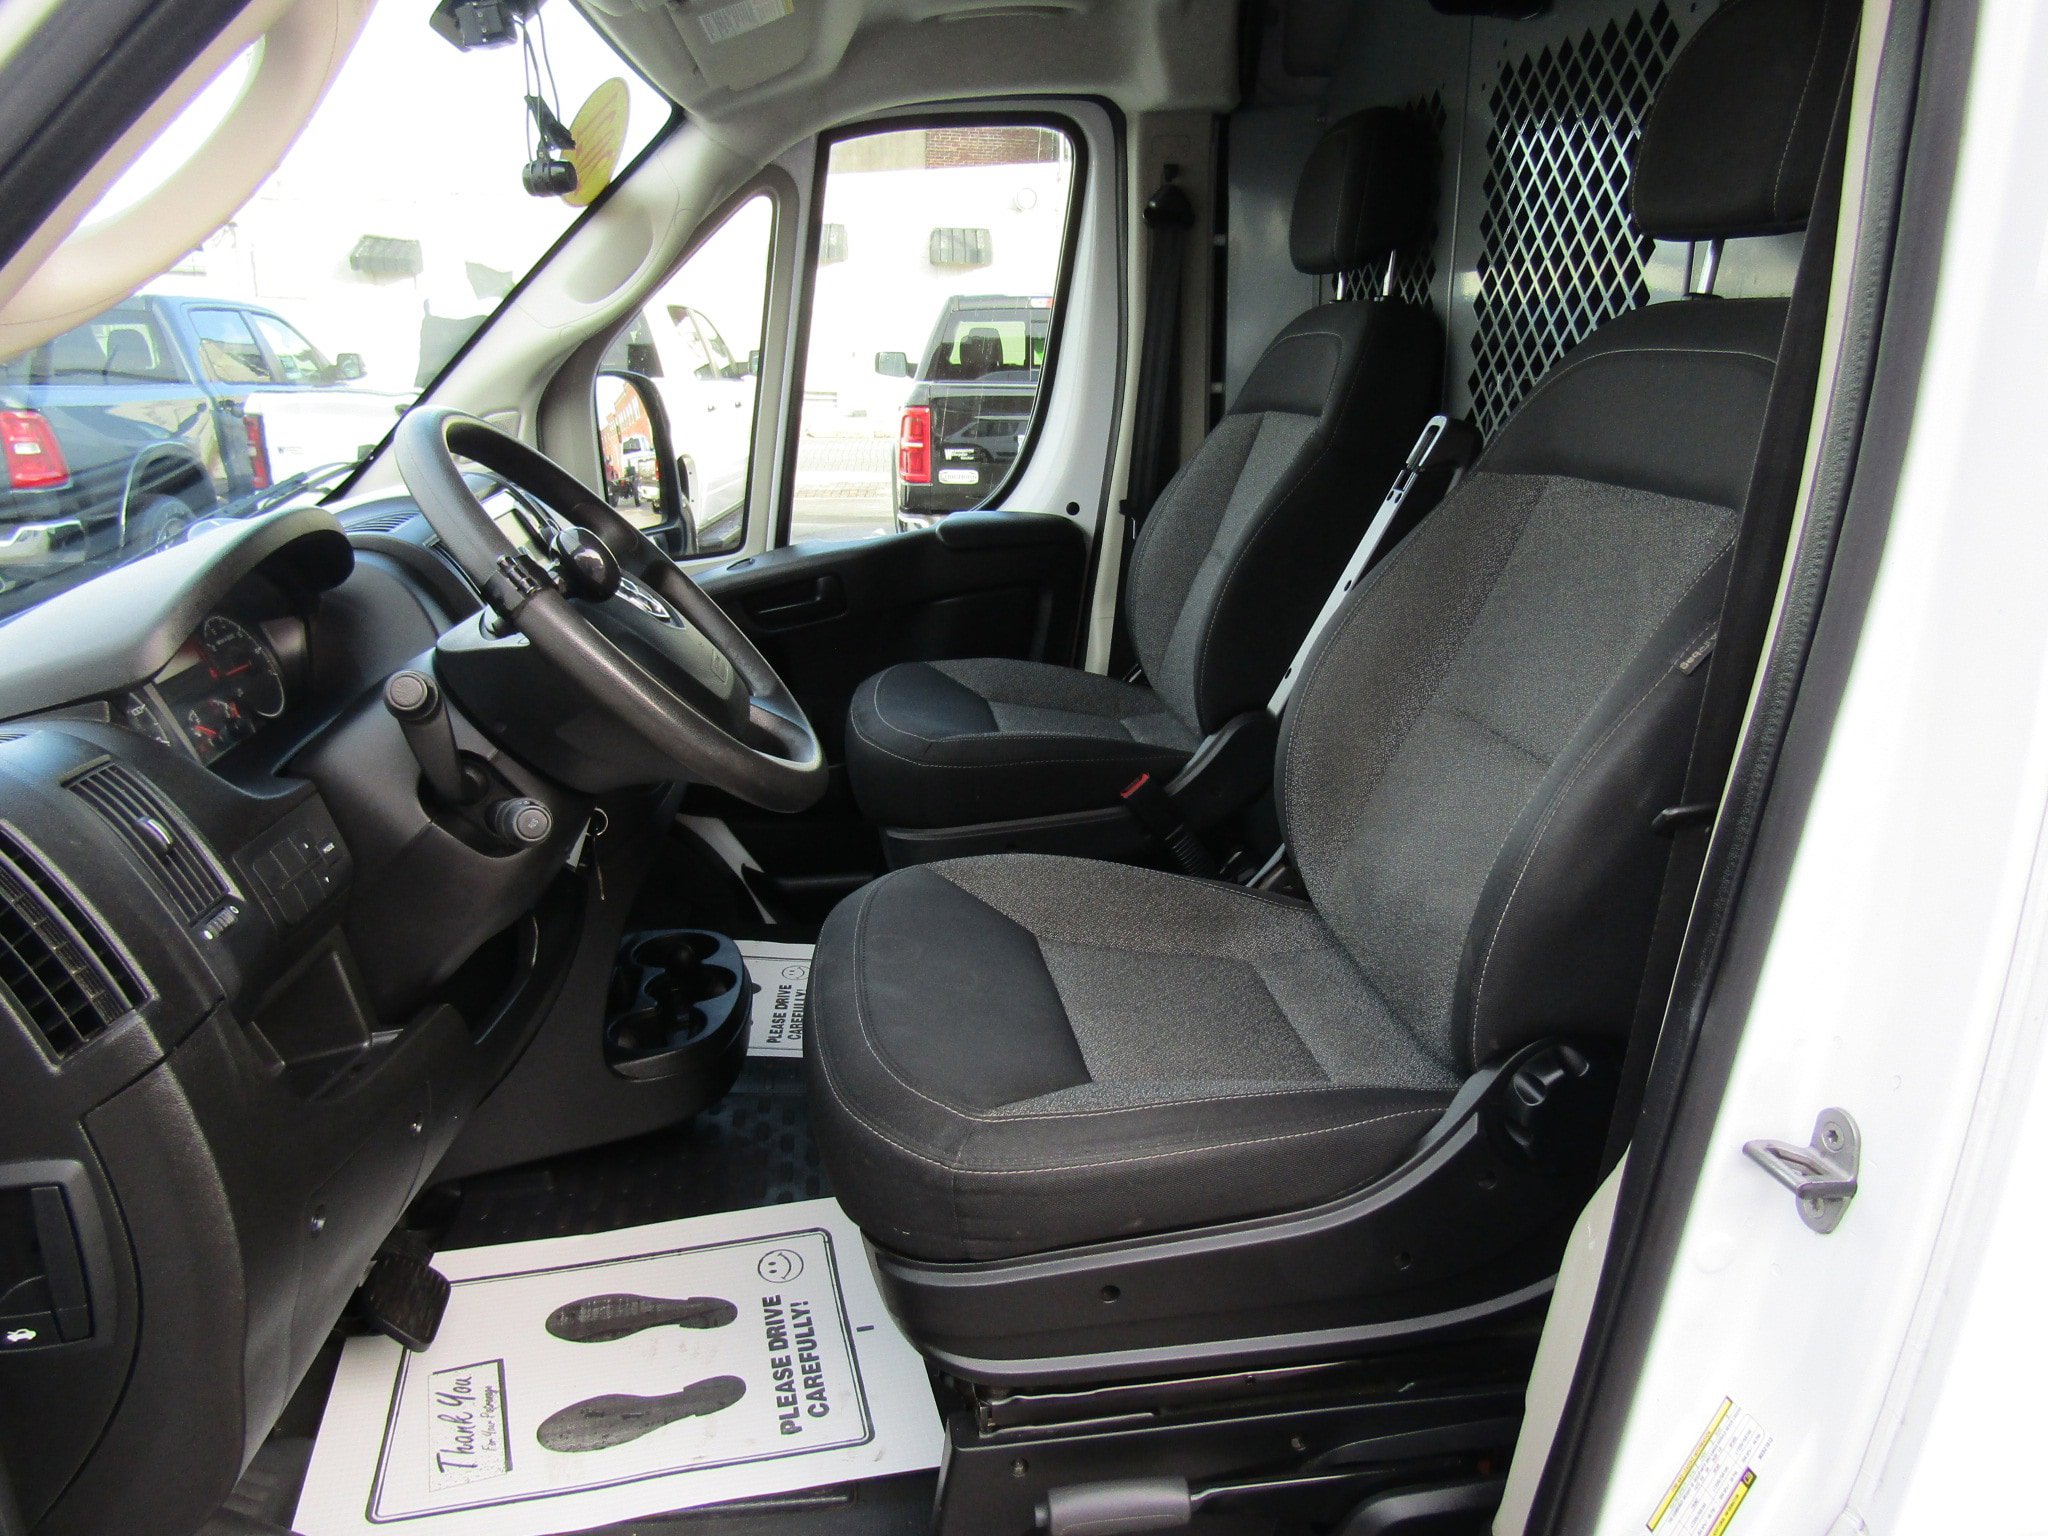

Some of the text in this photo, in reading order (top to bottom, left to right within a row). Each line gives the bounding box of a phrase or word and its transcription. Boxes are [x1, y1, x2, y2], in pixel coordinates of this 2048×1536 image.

[766, 984, 792, 1044] PLEASE DRIVE
[762, 1294, 803, 1435] PLEASE DRIVE
[790, 1300, 830, 1418] CAREFULLY!
[434, 1376, 478, 1473] Thank You
[482, 1438, 497, 1452] For
